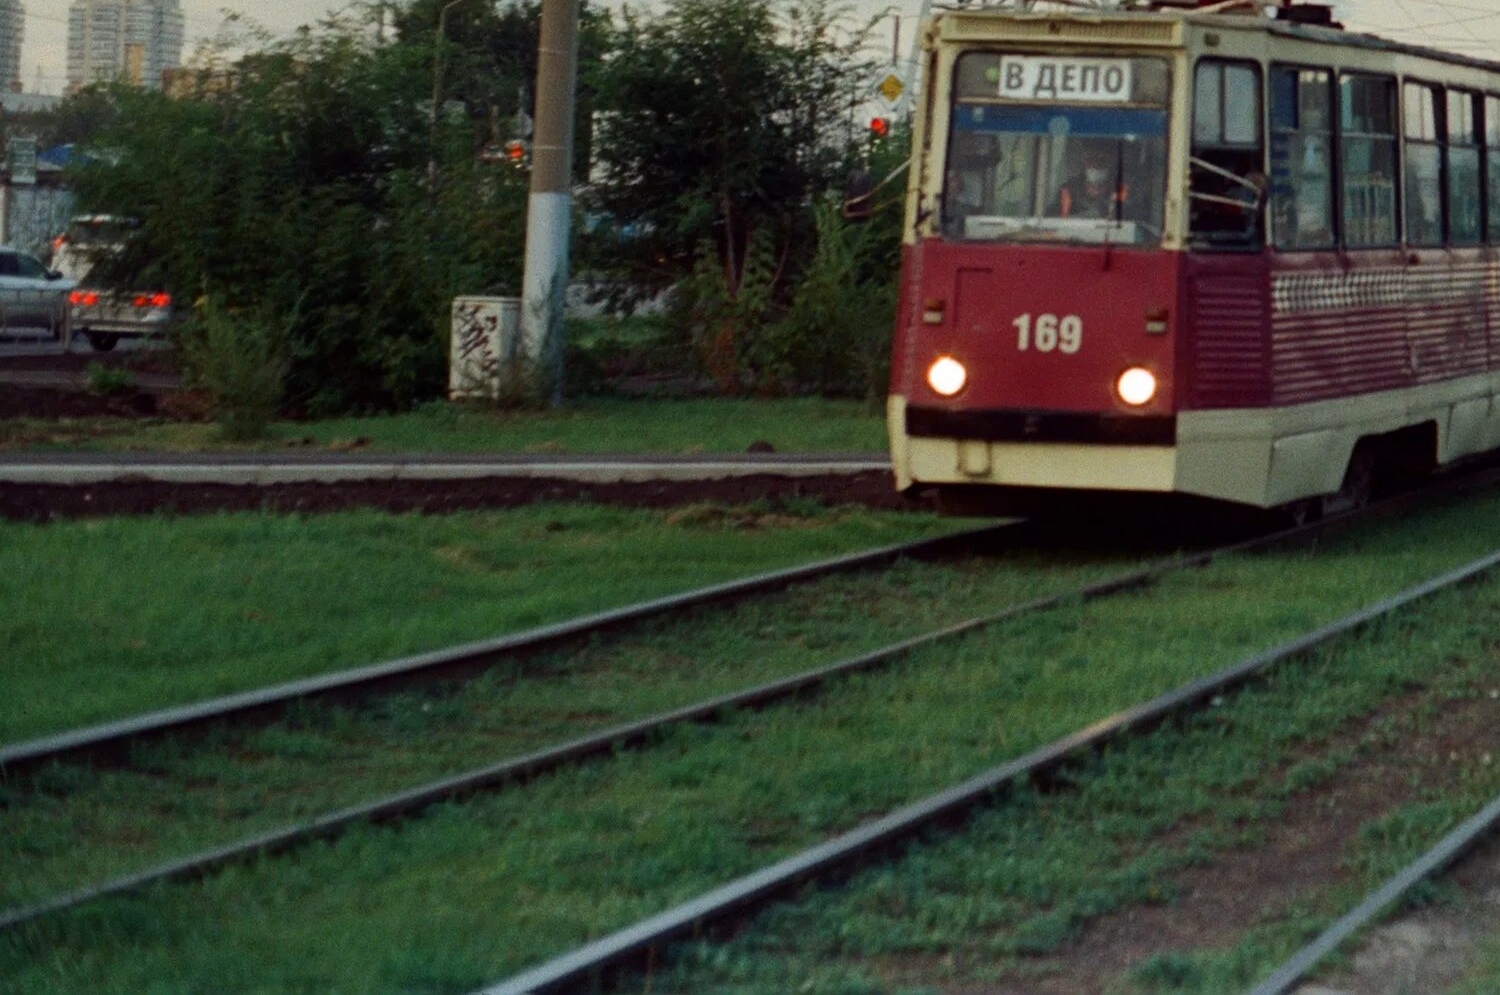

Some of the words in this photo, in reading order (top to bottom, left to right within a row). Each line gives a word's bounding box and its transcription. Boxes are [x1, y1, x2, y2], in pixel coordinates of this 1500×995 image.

[1005, 62, 1024, 90] В
[1033, 63, 1123, 98] ДЕПО
[1012, 312, 1083, 354] 169
